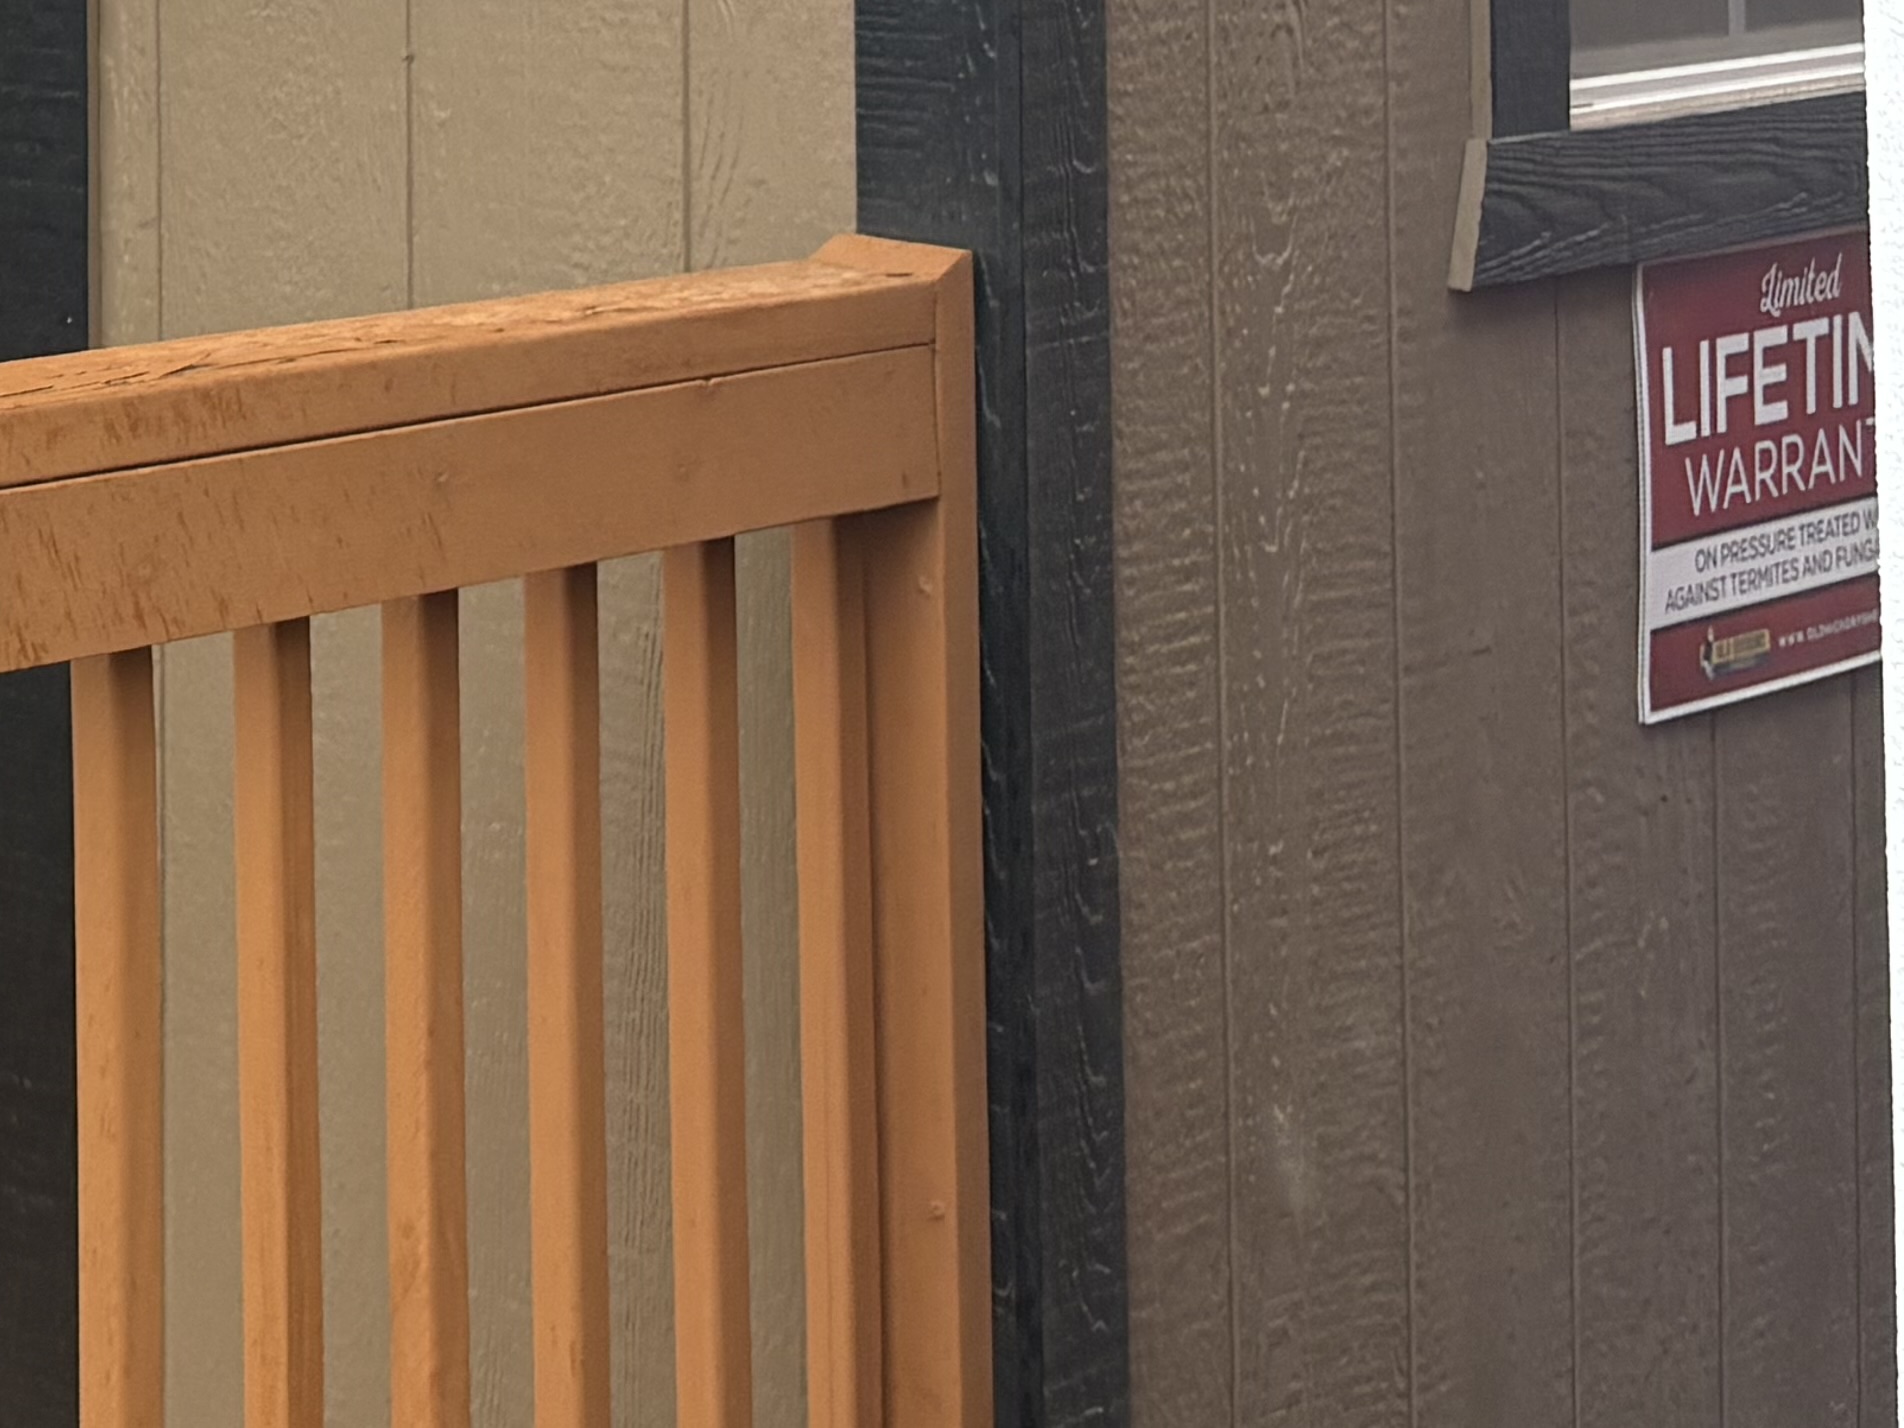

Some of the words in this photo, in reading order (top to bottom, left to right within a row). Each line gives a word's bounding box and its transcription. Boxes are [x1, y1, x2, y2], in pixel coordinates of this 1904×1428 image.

[1760, 252, 1843, 317] Limited
[1695, 548, 1718, 573] ON
[1721, 529, 1796, 565] PRESSURE
[1799, 512, 1860, 545] TREATED
[1666, 576, 1729, 612] AGAINST
[1730, 560, 1799, 593] TERMITES
[1802, 550, 1833, 577] AND
